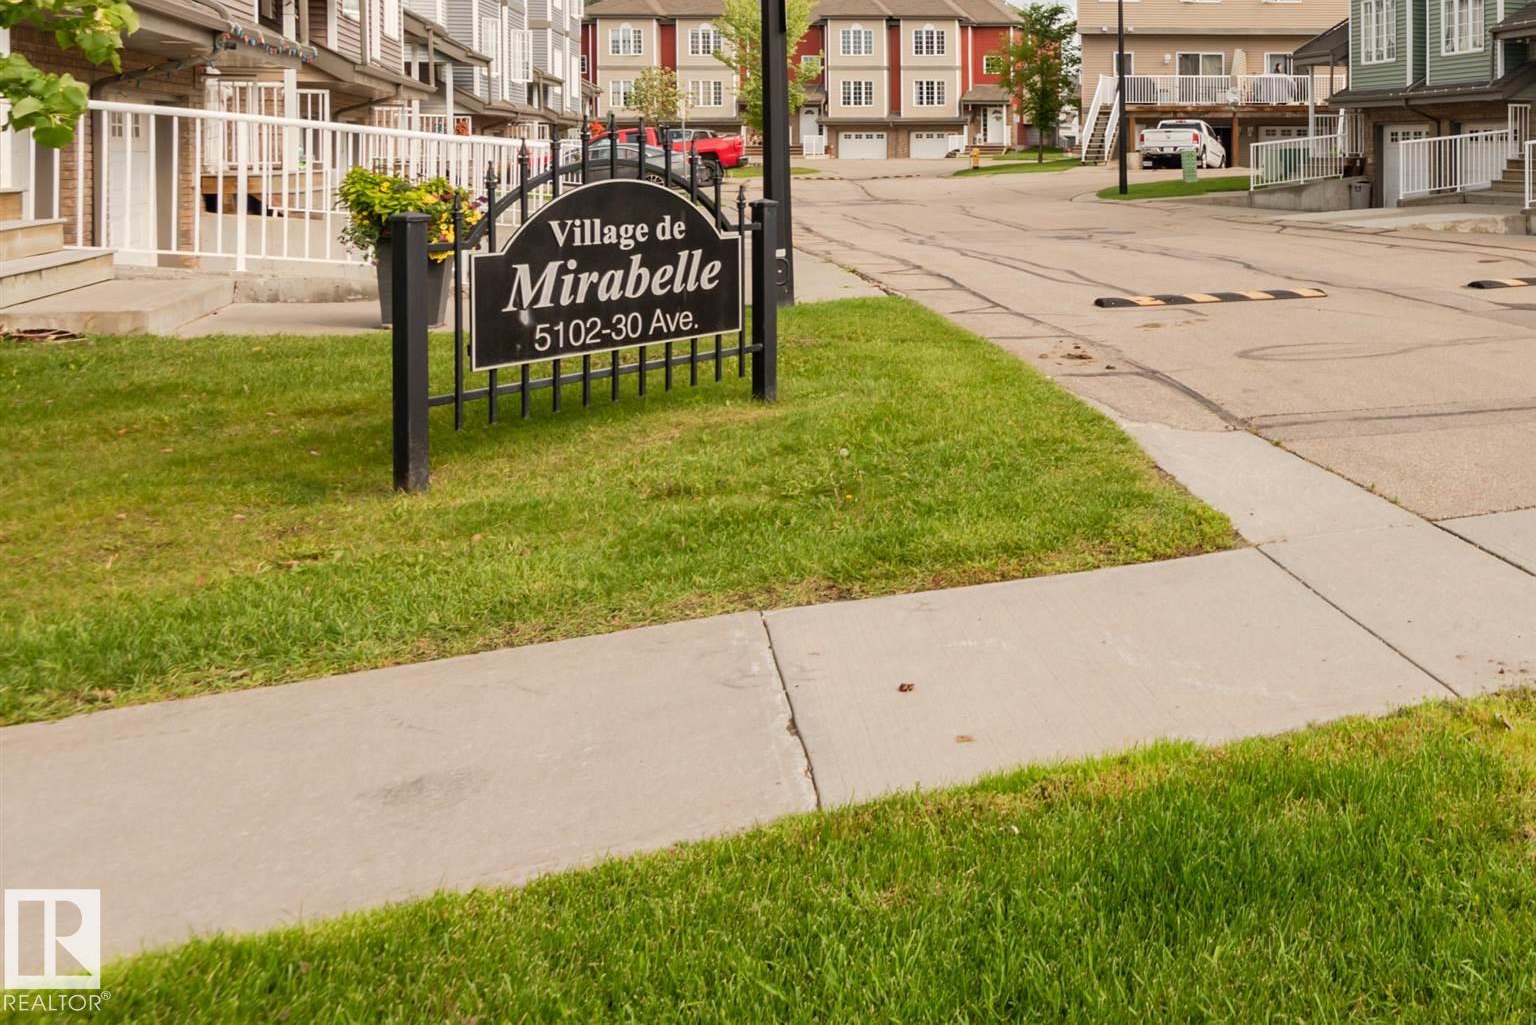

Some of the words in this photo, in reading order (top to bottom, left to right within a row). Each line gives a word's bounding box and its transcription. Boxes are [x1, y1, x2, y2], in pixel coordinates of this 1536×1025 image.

[549, 217, 649, 251] Village
[656, 215, 687, 242] de
[501, 249, 723, 313] Mirabelle
[534, 310, 643, 352] 5102-30
[648, 307, 700, 336] Ave.
